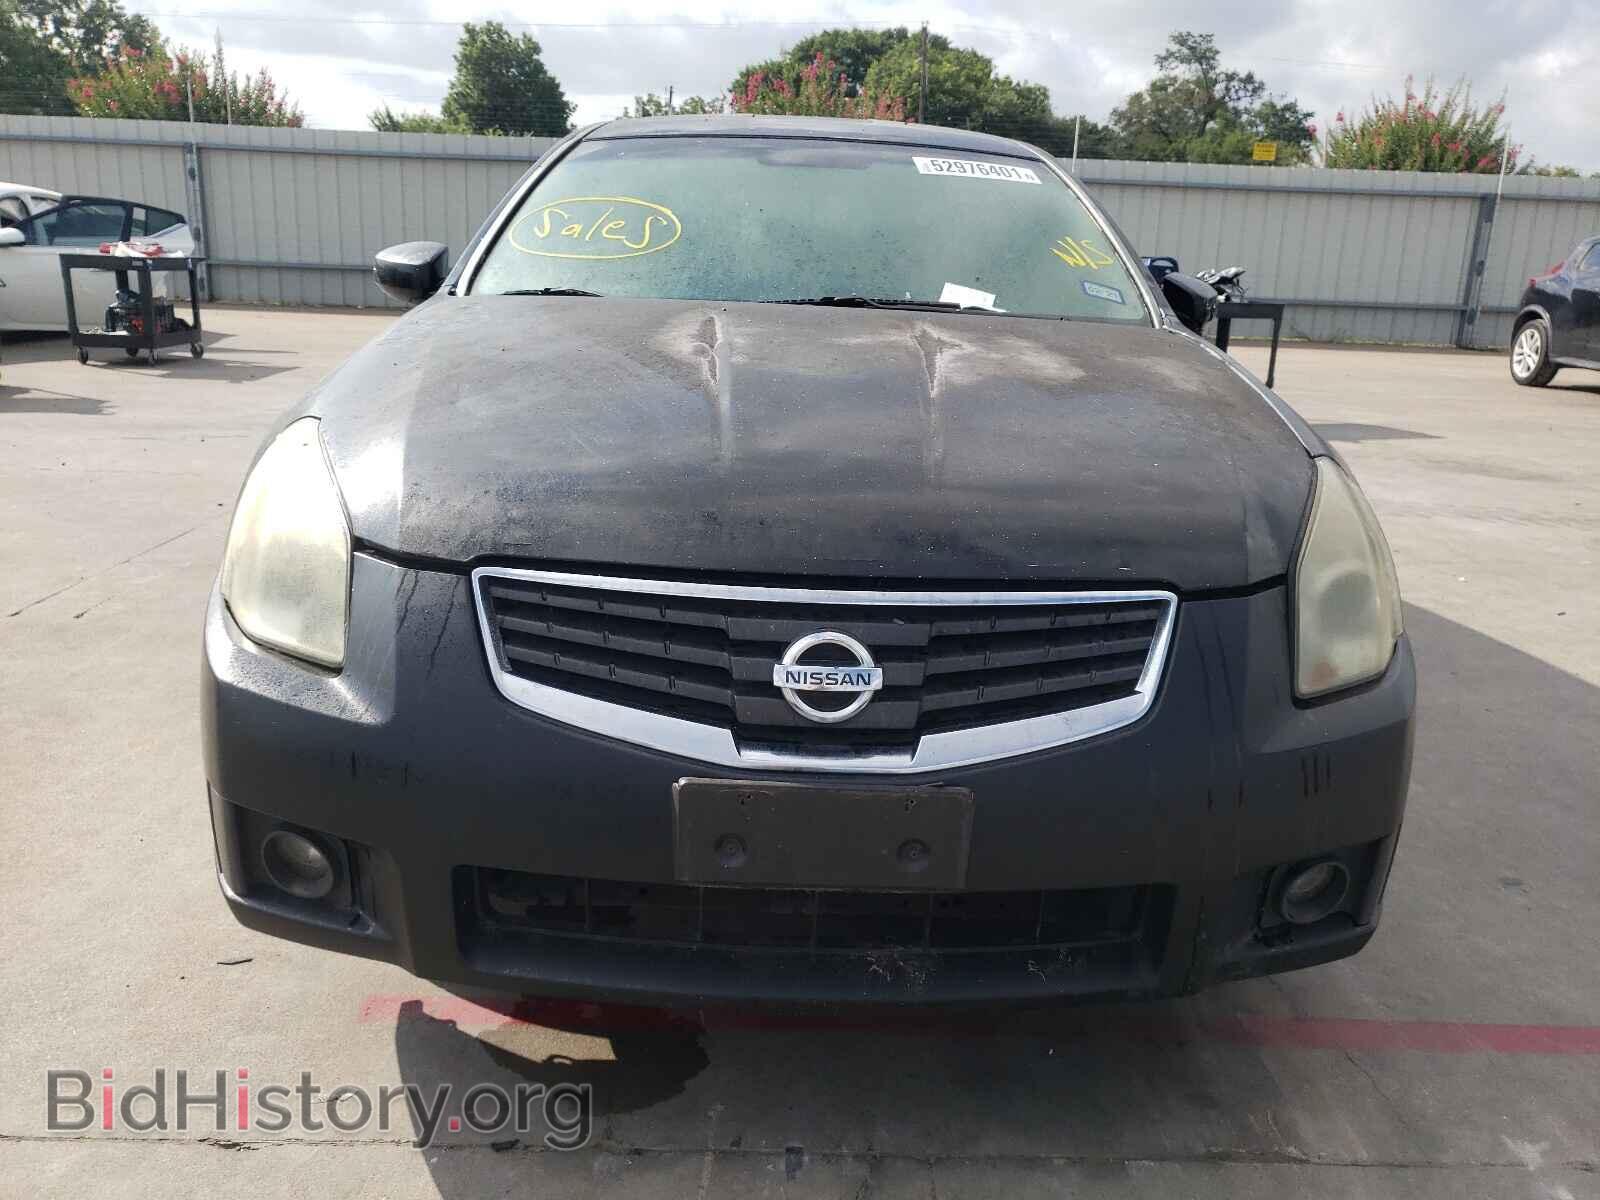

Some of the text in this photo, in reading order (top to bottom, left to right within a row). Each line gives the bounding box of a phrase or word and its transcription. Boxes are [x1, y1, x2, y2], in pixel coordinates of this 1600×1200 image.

[929, 159, 1023, 179] 52976401
[533, 207, 668, 249] Sales
[785, 670, 871, 686] NISSAN
